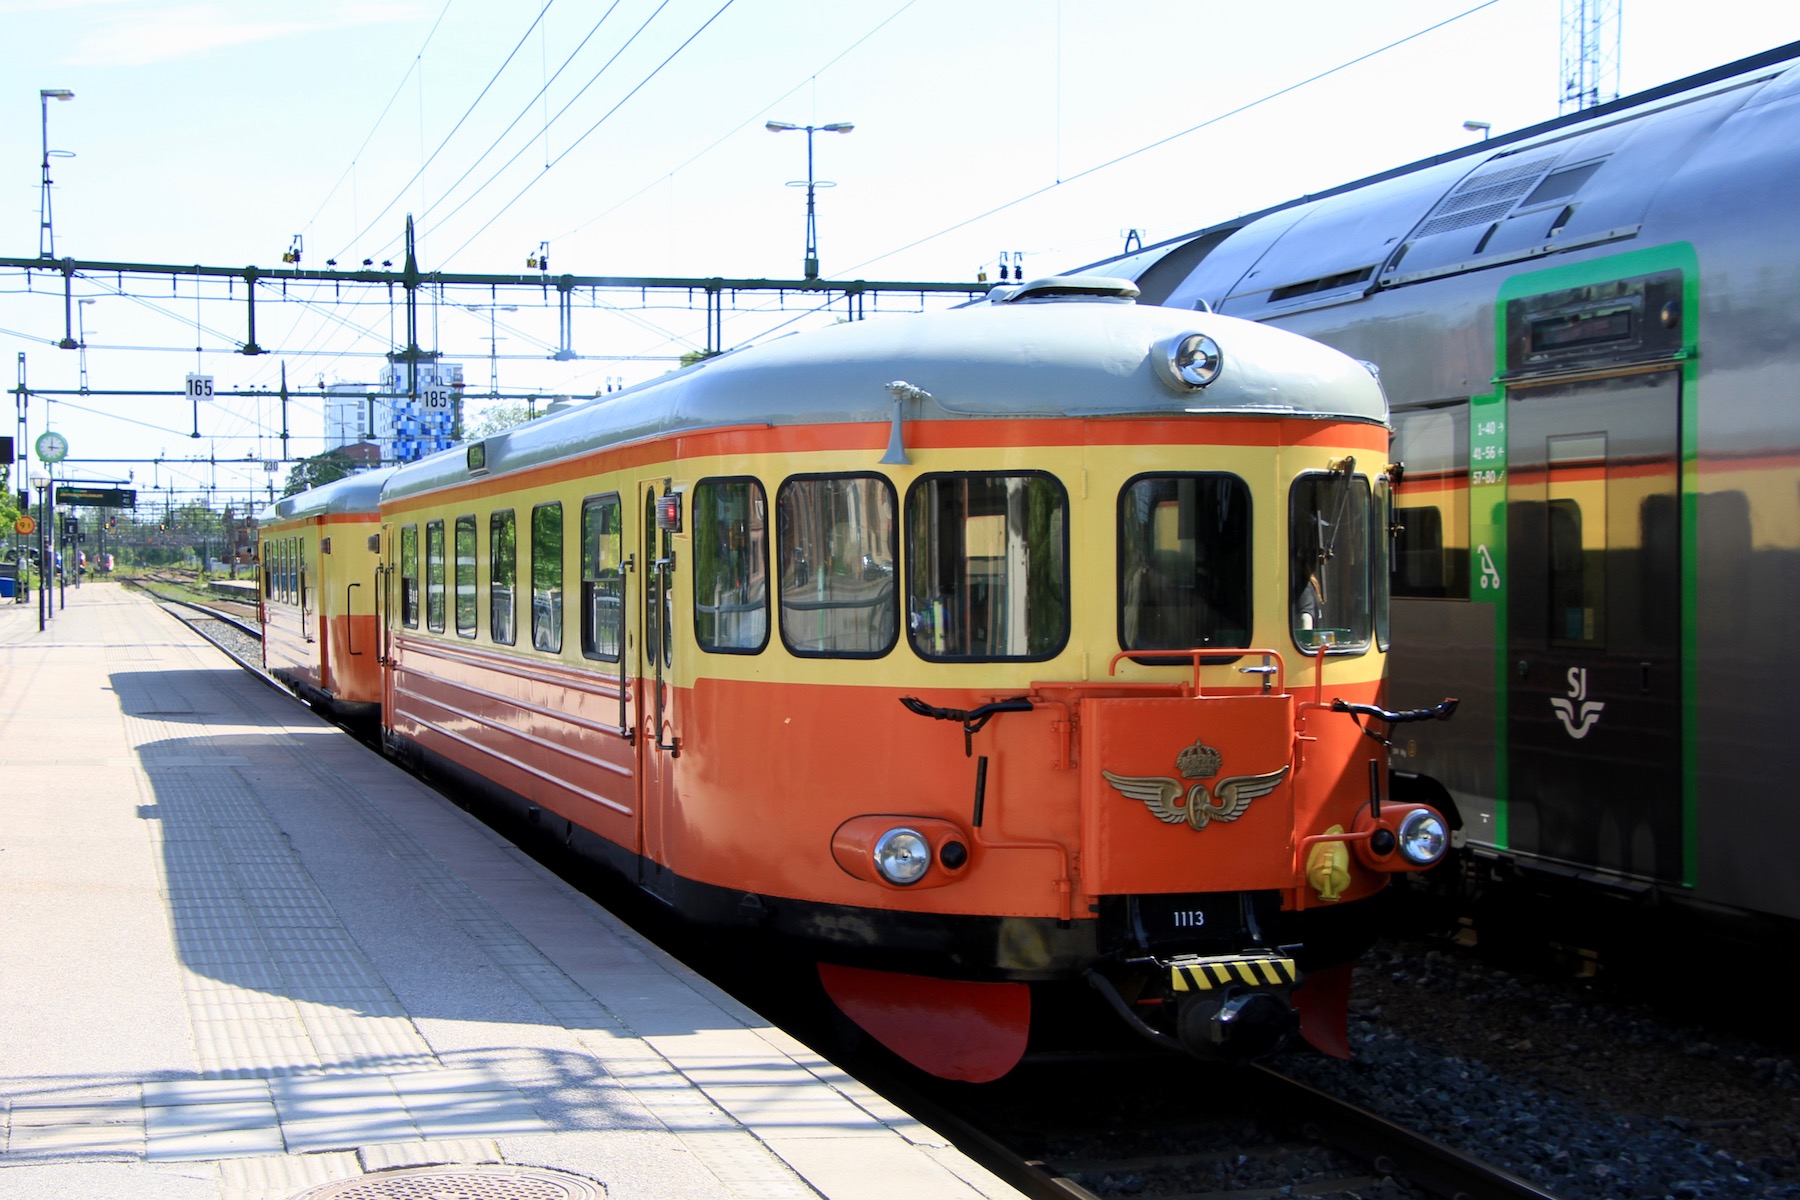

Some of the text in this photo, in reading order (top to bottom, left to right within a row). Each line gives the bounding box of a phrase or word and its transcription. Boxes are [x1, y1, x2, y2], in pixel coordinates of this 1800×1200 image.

[187, 379, 212, 397] 165
[423, 390, 447, 408] 185
[1477, 421, 1496, 436] 1-40
[1472, 446, 1496, 460] 41-56
[264, 460, 279, 471] 230
[1567, 666, 1587, 701] SJ
[1173, 911, 1204, 927] 1113
